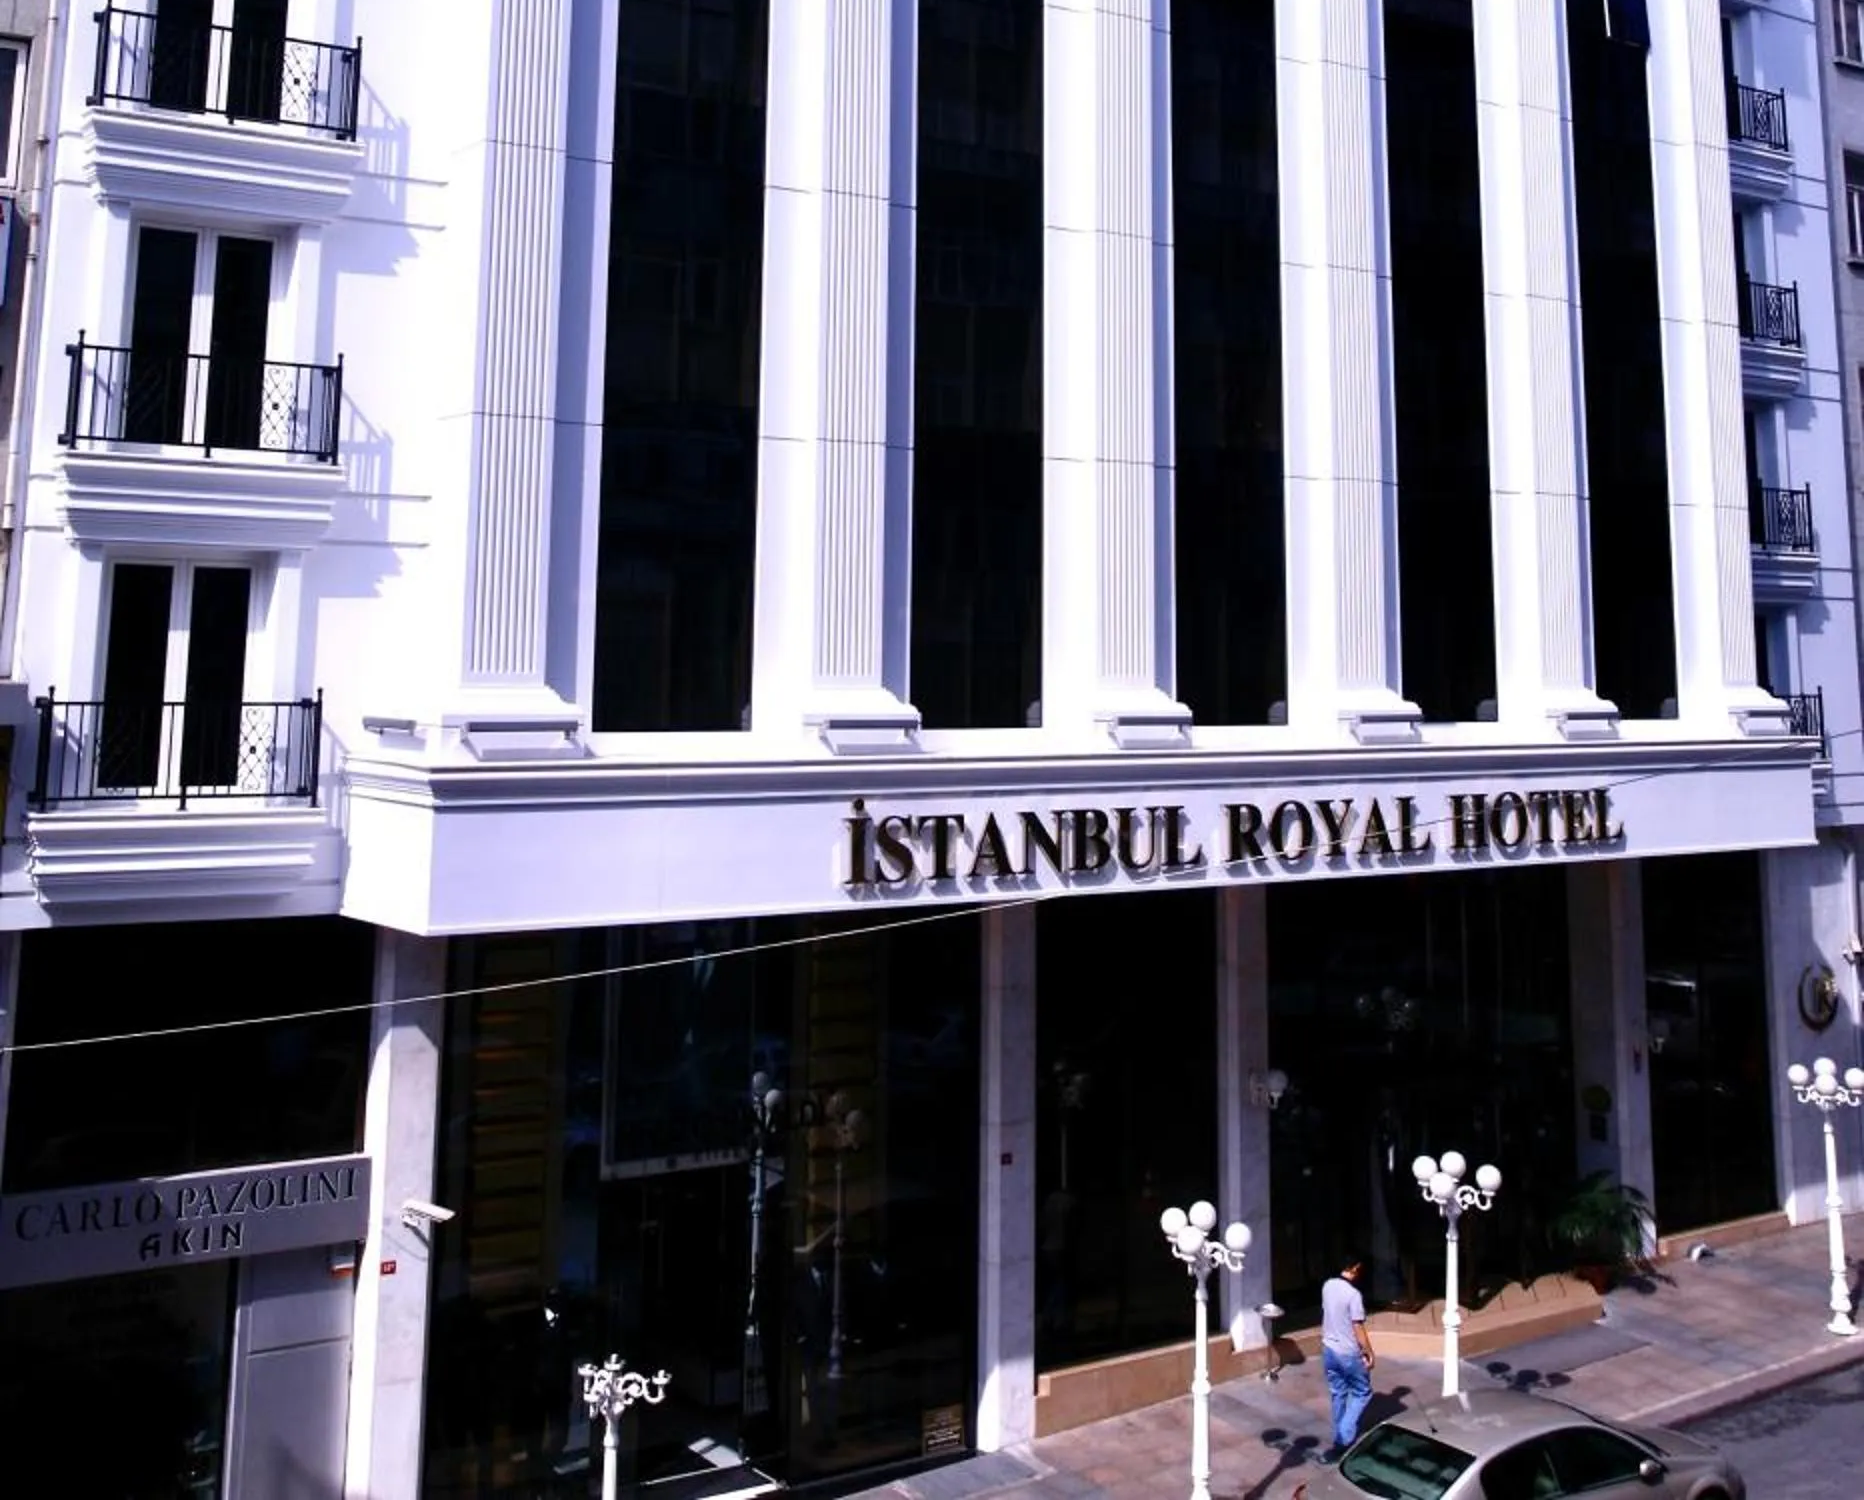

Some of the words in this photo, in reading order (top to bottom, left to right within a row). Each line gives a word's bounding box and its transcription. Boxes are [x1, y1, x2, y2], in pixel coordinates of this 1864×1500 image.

[843, 798, 1202, 887] İSTANBUL
[1222, 796, 1433, 864] ROYAL
[1445, 786, 1625, 850] HOTEL
[15, 1190, 163, 1242] CARLO
[176, 1167, 360, 1221] PAZOLINI
[139, 1222, 244, 1262] AKIN
